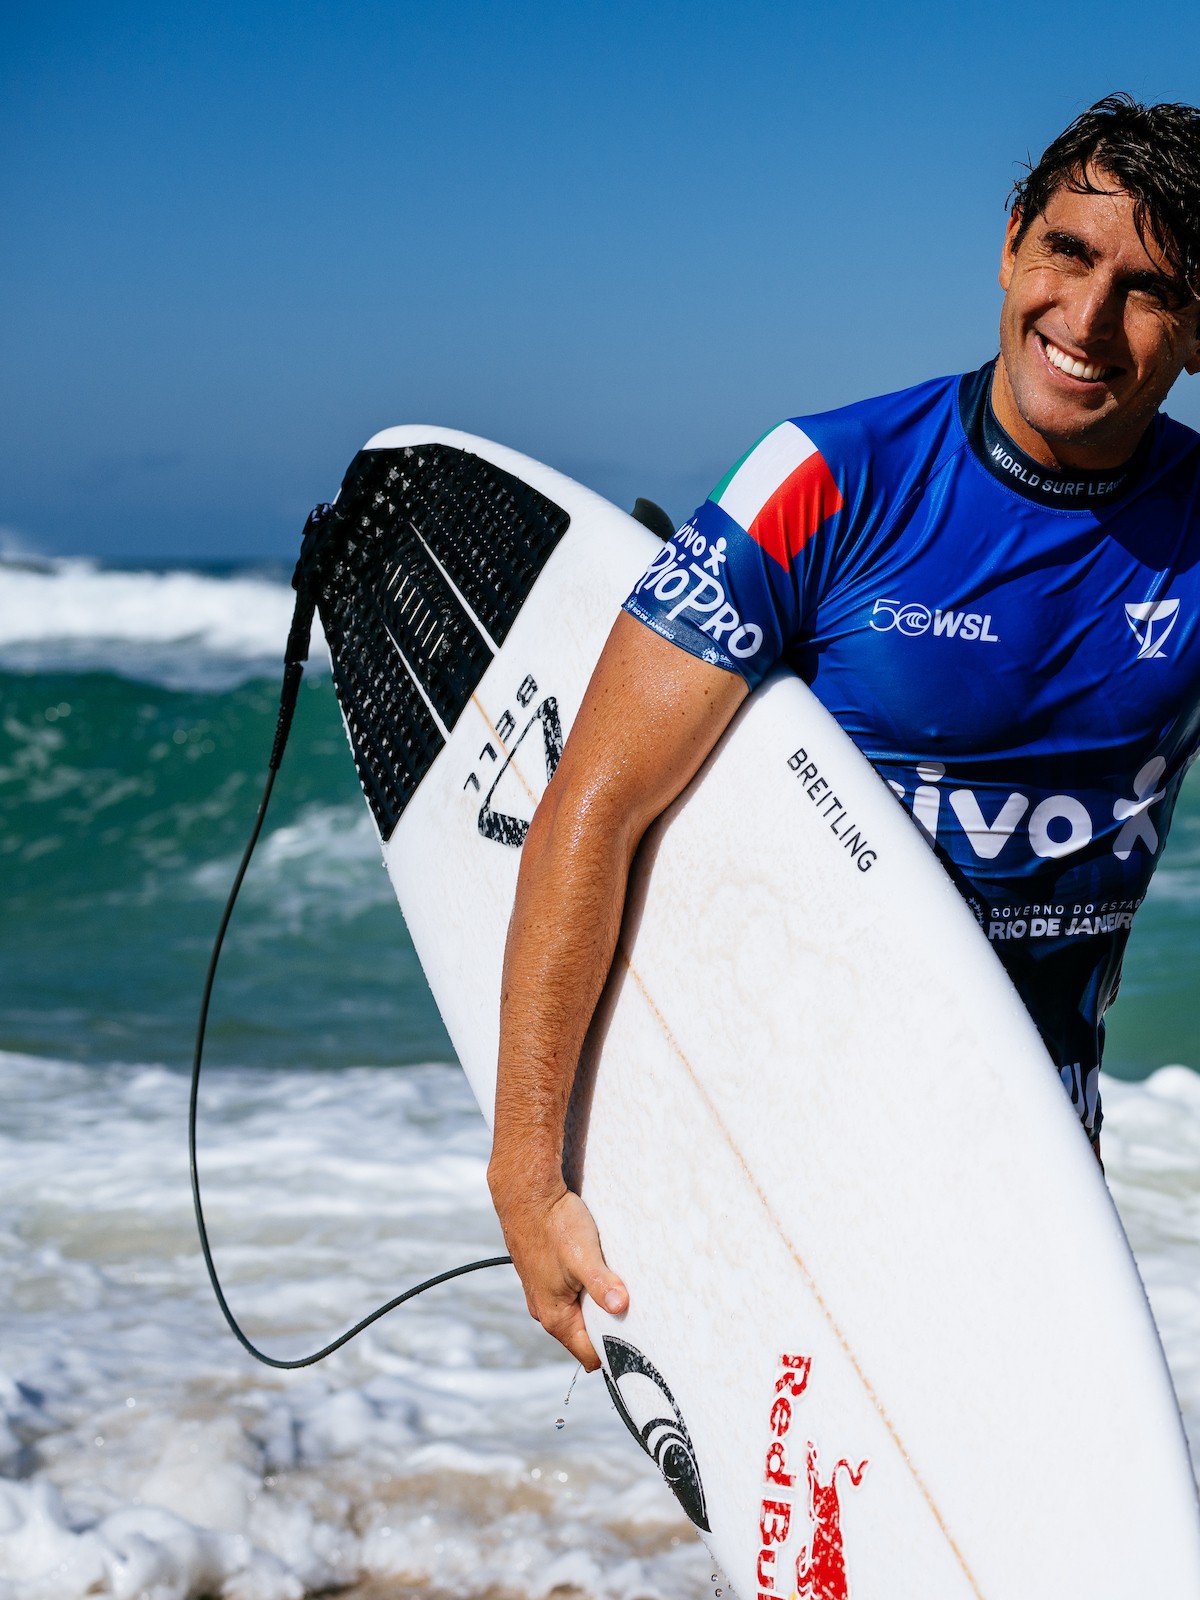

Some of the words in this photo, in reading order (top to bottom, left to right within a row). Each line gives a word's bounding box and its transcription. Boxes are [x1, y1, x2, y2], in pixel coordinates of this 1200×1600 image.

[991, 443, 1041, 487] WORLD
[1041, 479, 1085, 496] SURF
[1087, 473, 1128, 496] LEA
[933, 609, 999, 642] WSL
[786, 747, 878, 873] BREITLING
[887, 761, 1093, 860] ivo
[988, 918, 1028, 940] RIO
[1029, 917, 1062, 937] DE
[1064, 912, 1134, 936] JANEIR
[991, 904, 1065, 919] GOVERNO
[1073, 903, 1094, 915] DO
[1100, 897, 1143, 912] ESTAD
[763, 1353, 813, 1487] Red
[756, 1499, 792, 1600] Bu
